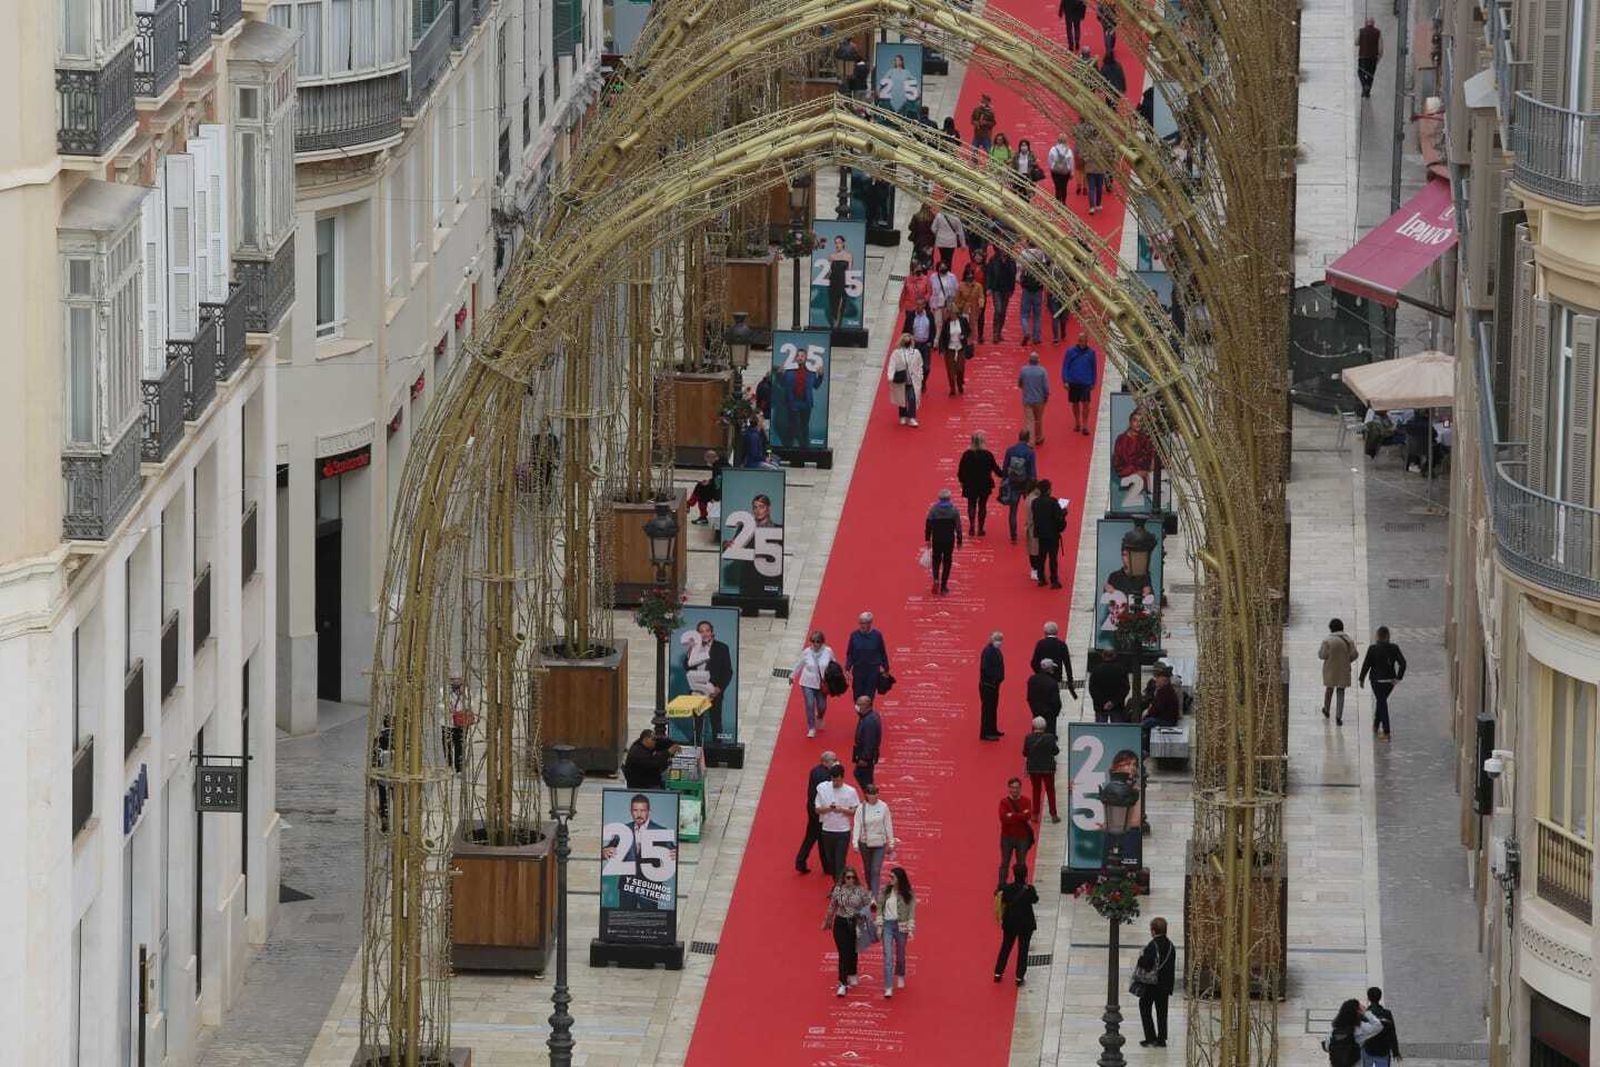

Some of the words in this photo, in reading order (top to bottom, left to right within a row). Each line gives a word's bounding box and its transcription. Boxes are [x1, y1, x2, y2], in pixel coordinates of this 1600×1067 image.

[1395, 211, 1453, 245] LEPANTO
[721, 510, 782, 577] 25
[602, 822, 677, 882] 25
[623, 884, 634, 893] DE
[625, 876, 632, 884] Y
[632, 878, 673, 894] SEGUIMOS
